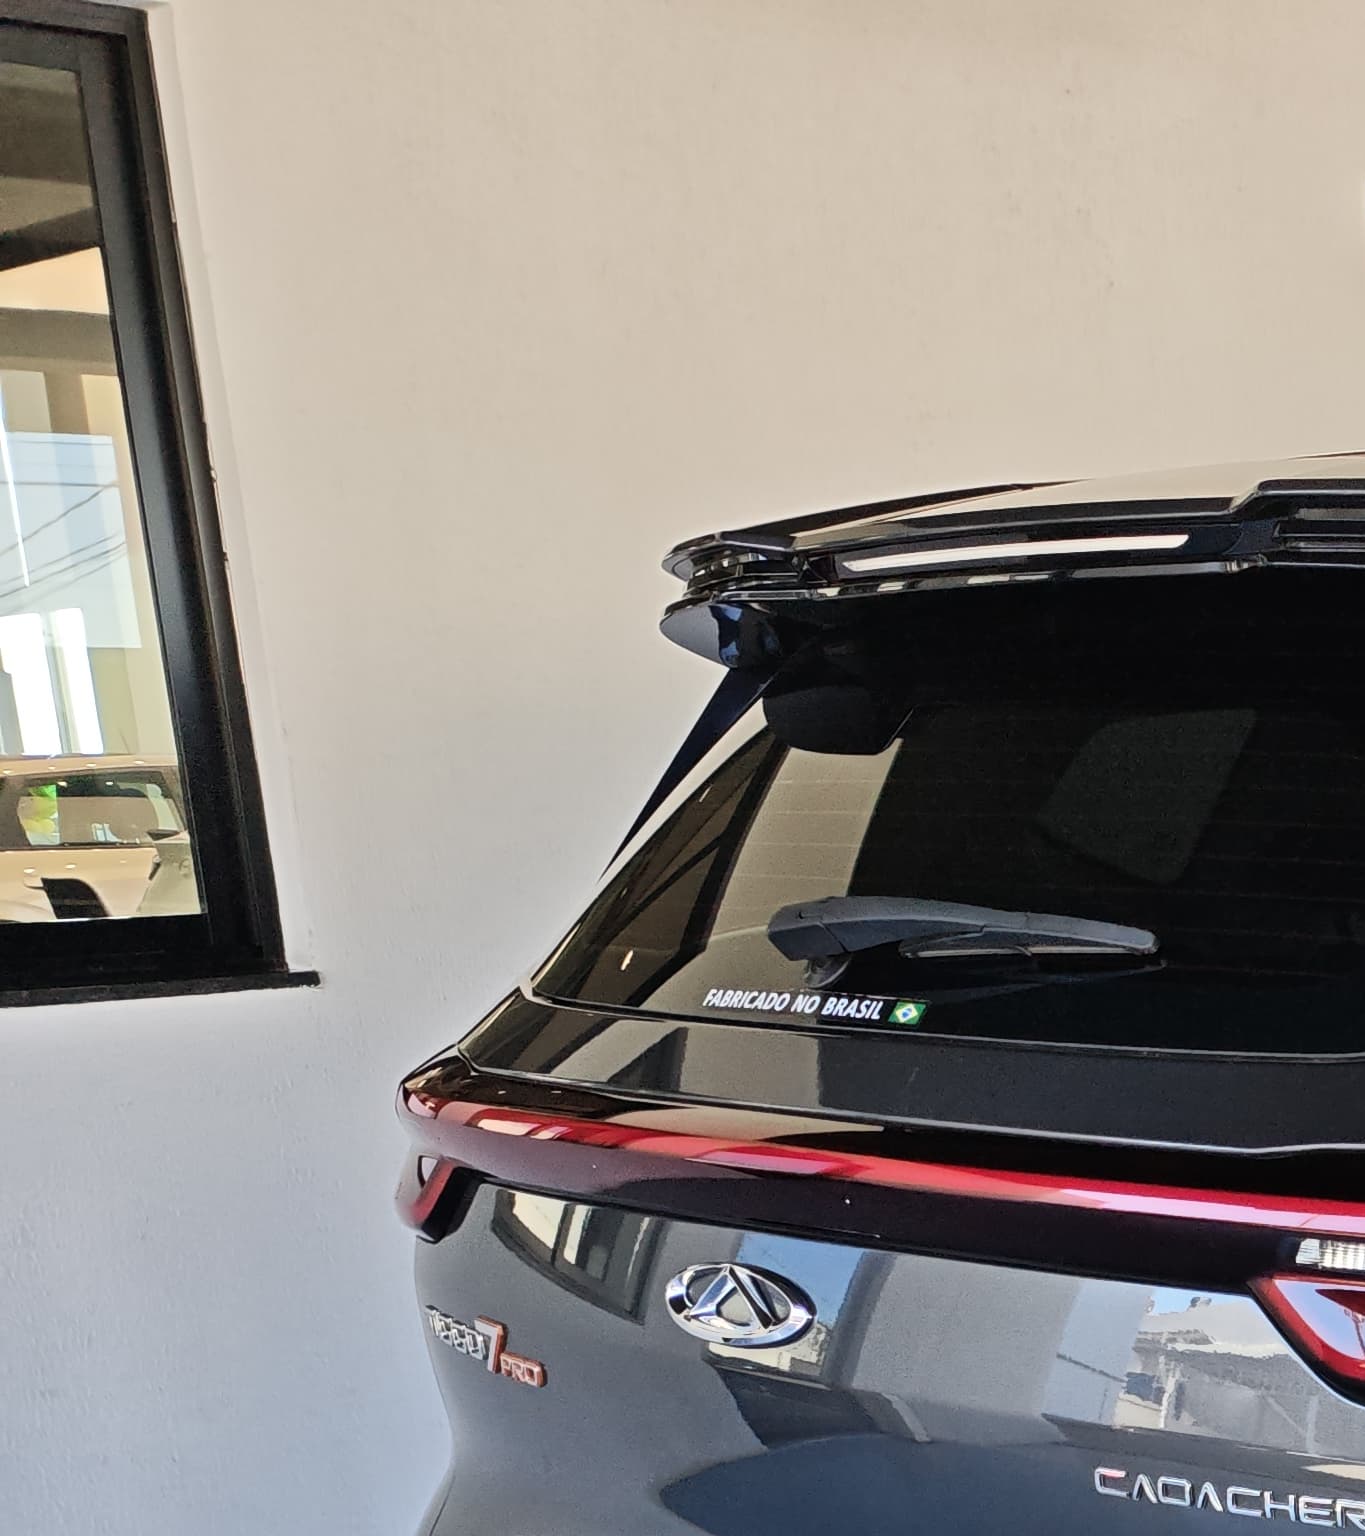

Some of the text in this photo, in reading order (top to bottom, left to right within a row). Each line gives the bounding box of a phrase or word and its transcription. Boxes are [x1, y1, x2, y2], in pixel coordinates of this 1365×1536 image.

[702, 988, 884, 1020] FABRICADO NO BRASIL
[499, 1352, 548, 1388] PRO
